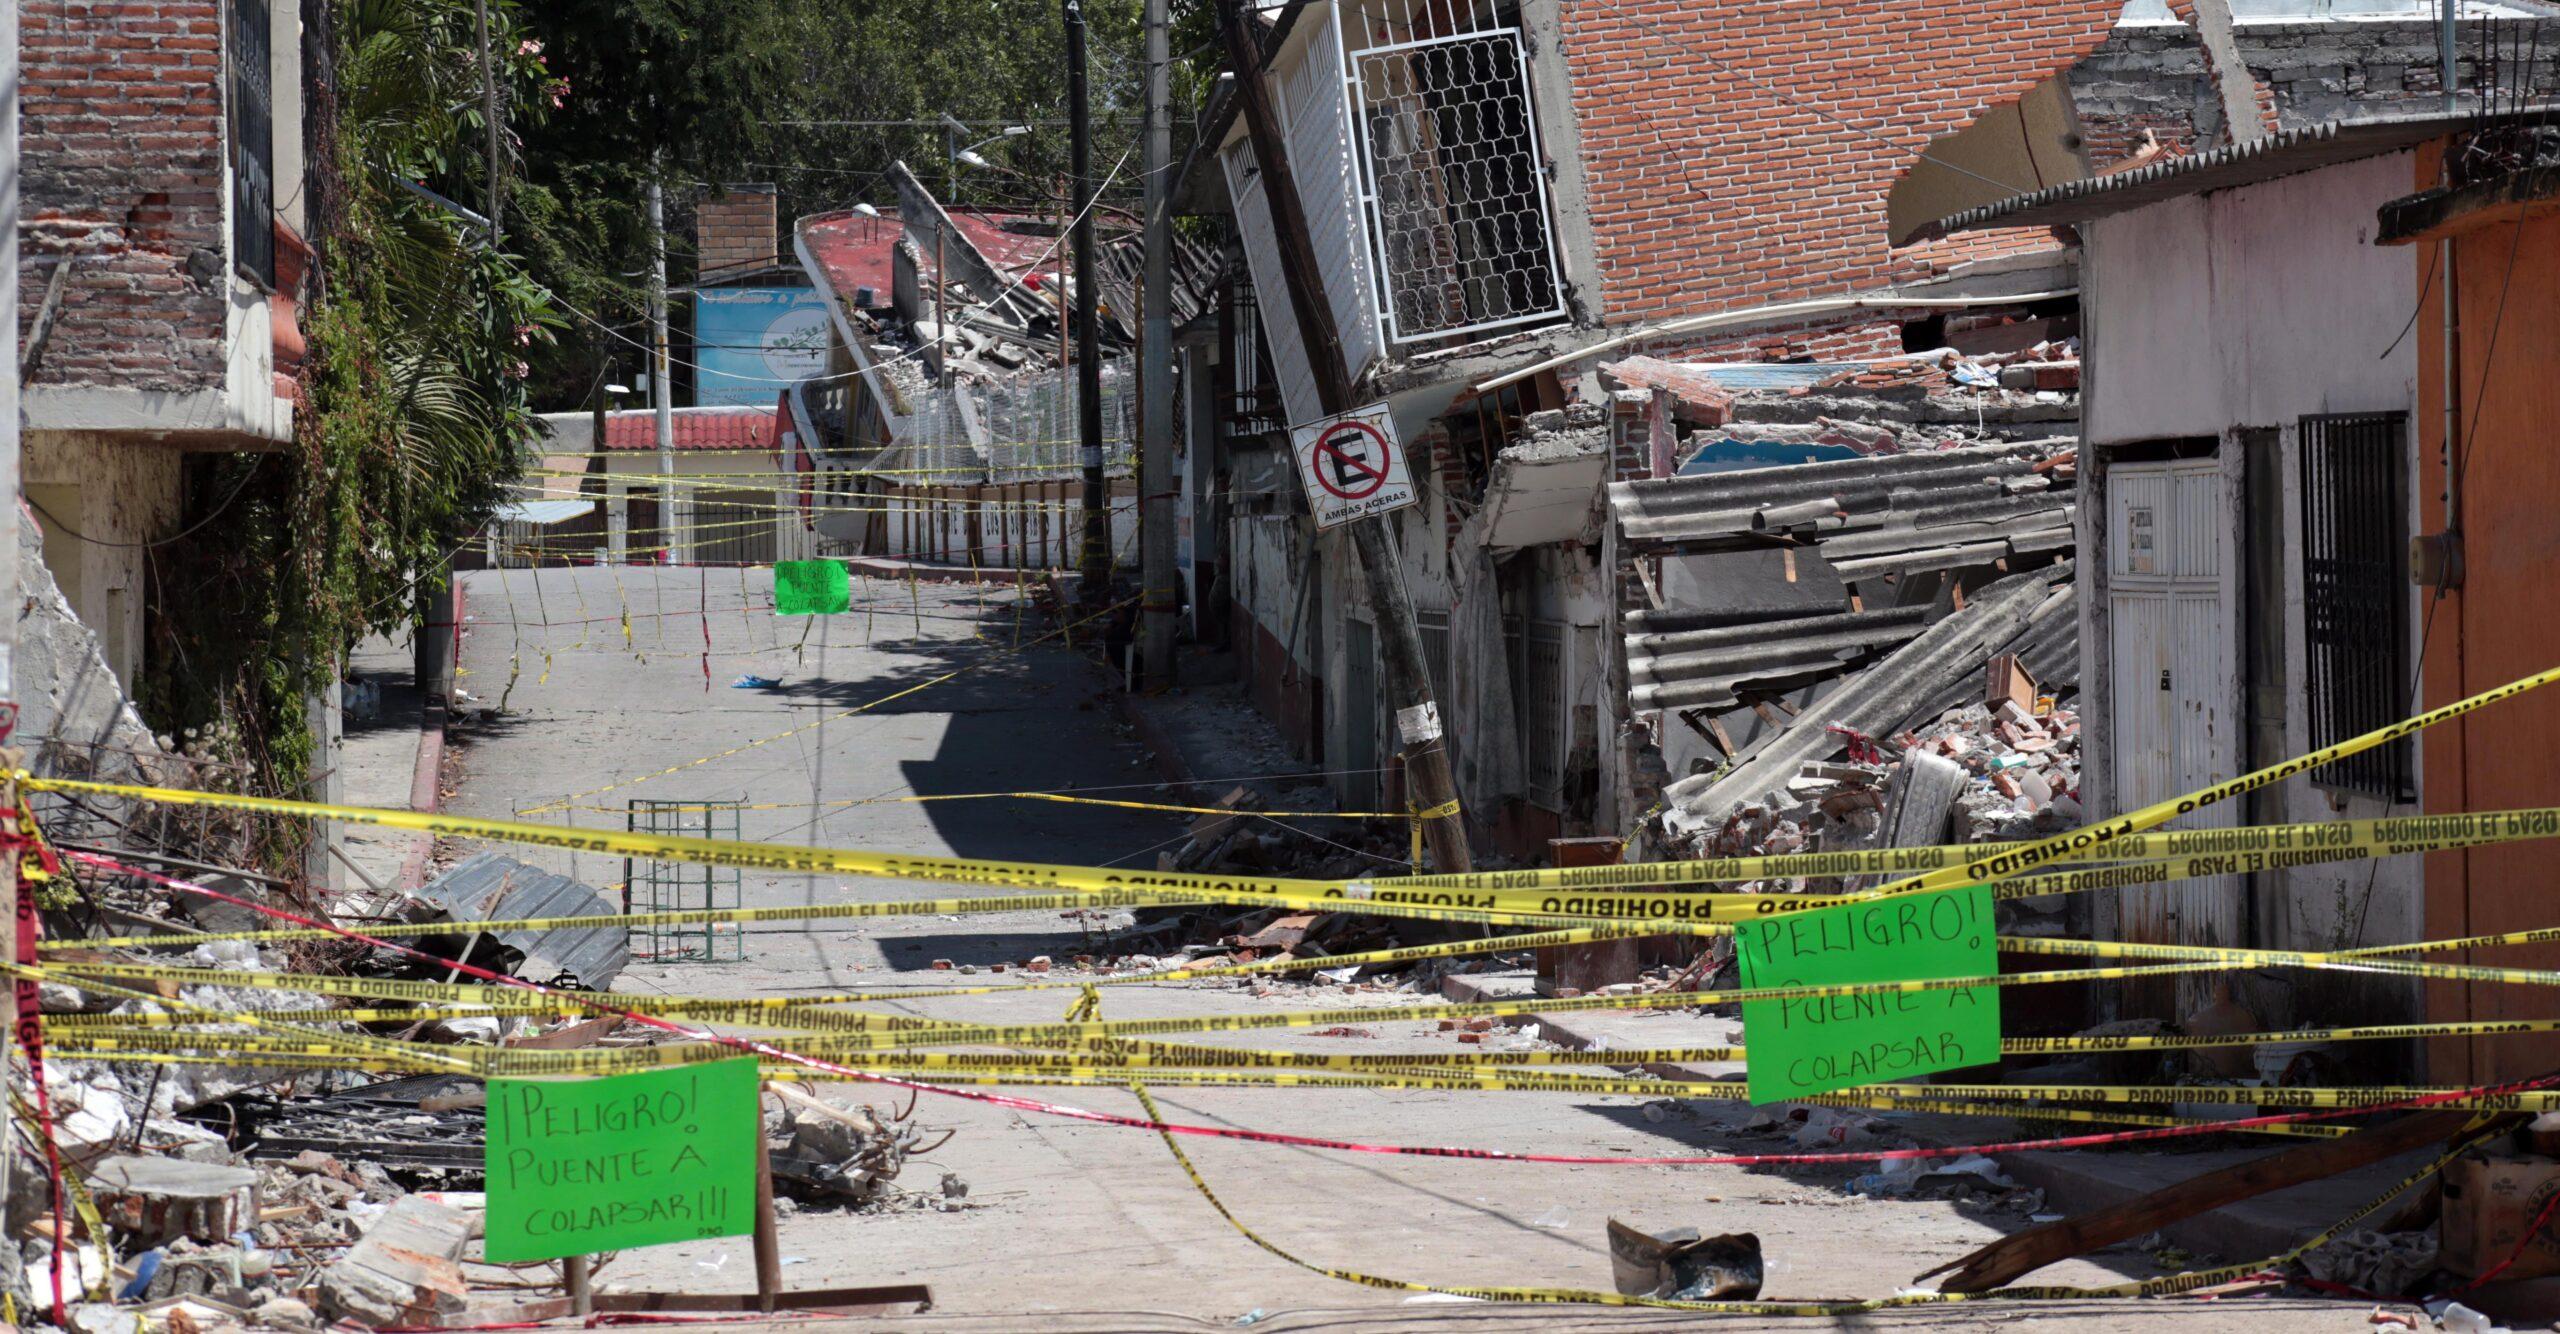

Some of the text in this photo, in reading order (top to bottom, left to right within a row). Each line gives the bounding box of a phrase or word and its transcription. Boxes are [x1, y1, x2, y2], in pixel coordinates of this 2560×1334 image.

[1325, 491, 1408, 521] AMBAS ACERAS
[1968, 819, 2133, 881] PROHIBIDO
[2242, 851, 2264, 870] EL
[2187, 853, 2237, 877] PASO
[1992, 877, 2038, 900] PASO
[2045, 875, 2063, 893] EL
[2069, 863, 2167, 891] PROHIBIDO
[1541, 896, 1712, 919] PROHIBIDO
[359, 979, 461, 1002] PROHIBIDO
[481, 986, 531, 1007] PASO
[745, 1006, 762, 1025] EL
[768, 1006, 867, 1033] PROHIBIDO
[1550, 1050, 1650, 1064] PROHIBIDO
[1655, 1048, 1676, 1062] EL
[1682, 1048, 1731, 1062] PASO
[1788, 1032, 1964, 1087] COLAPSAR
[501, 1074, 698, 1146] ¡PELIGRO!
[2127, 1089, 2229, 1104] PROHIBIDO
[2235, 1090, 2256, 1105] EL
[2263, 1090, 2315, 1106] PASO
[2470, 1094, 2521, 1110] PASO
[508, 1144, 708, 1190] PUENTE A
